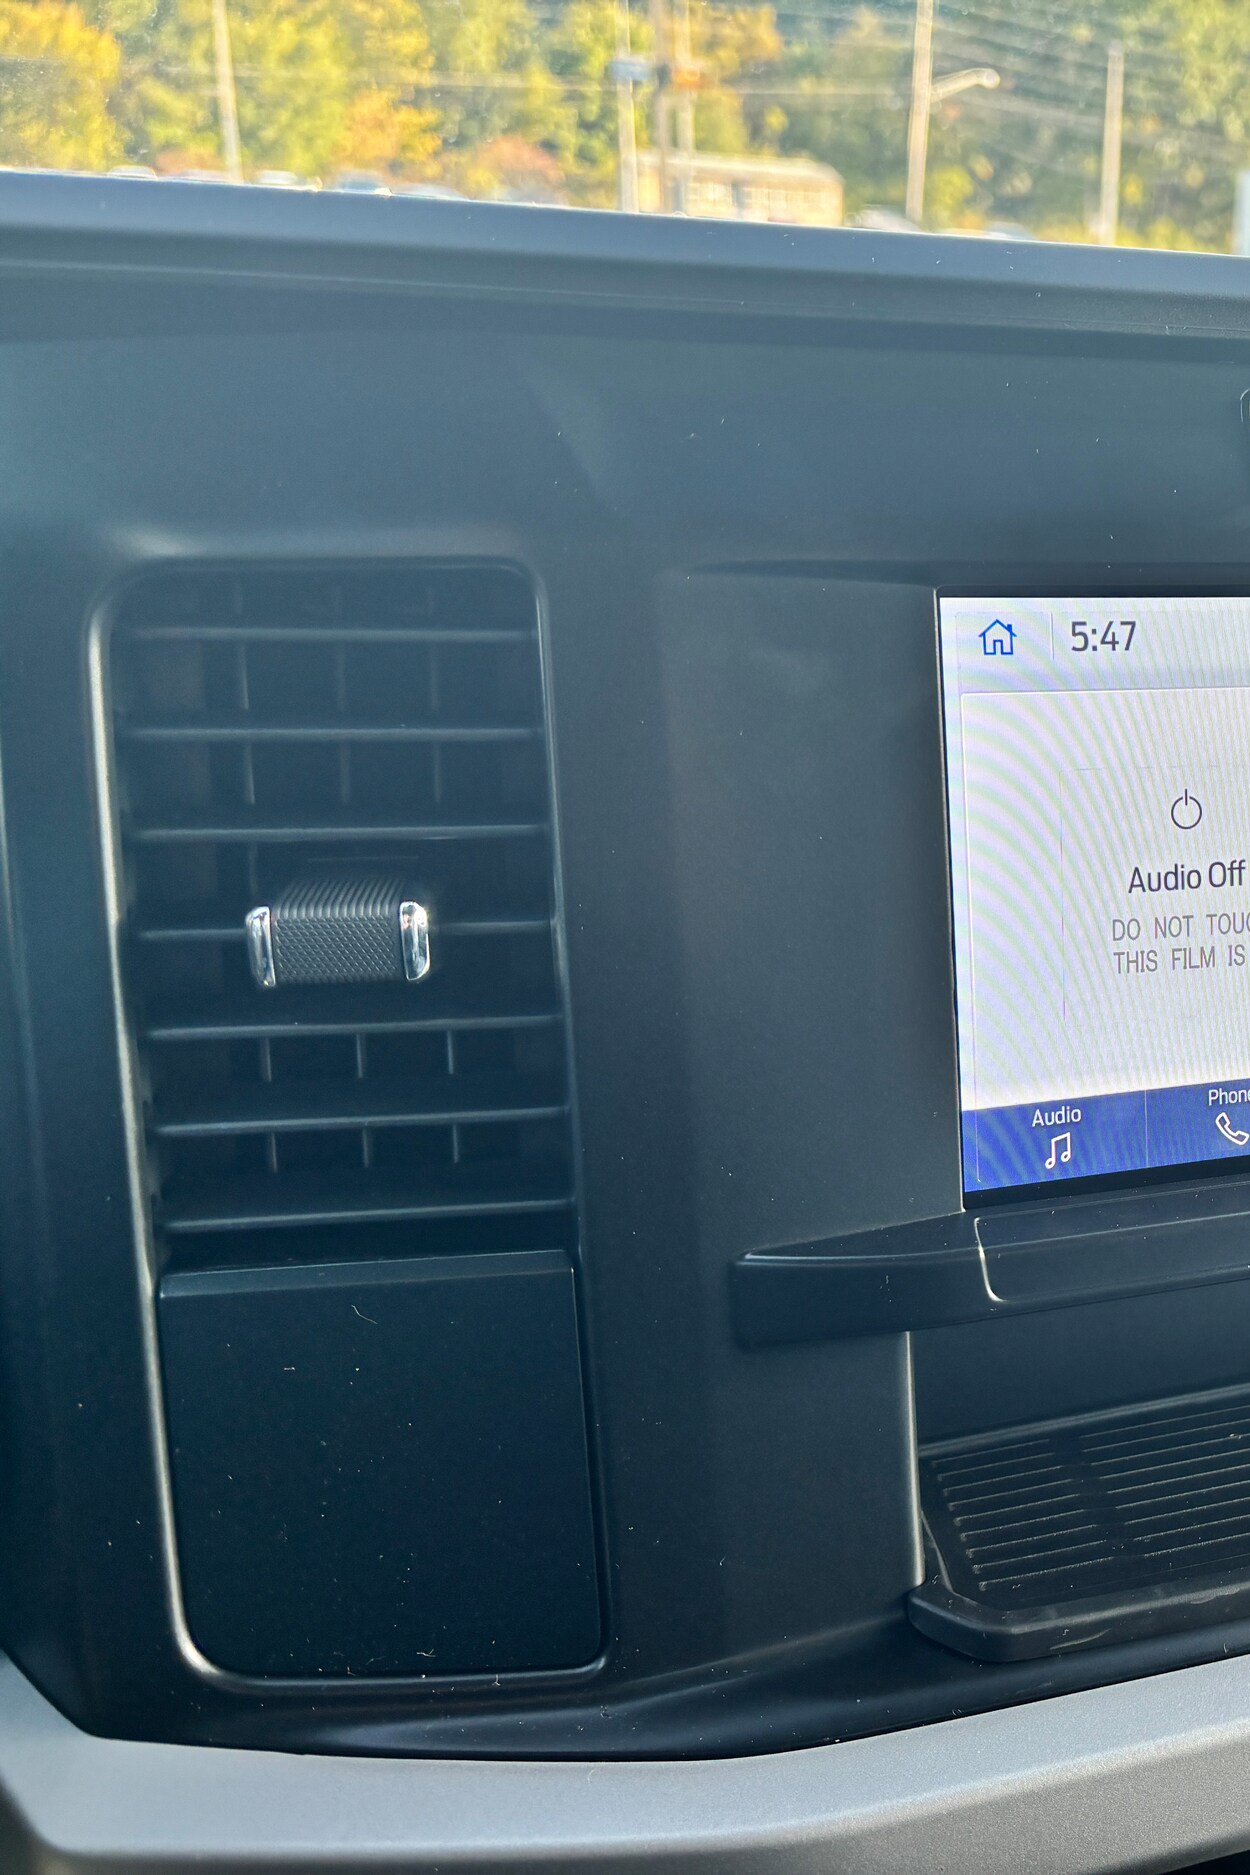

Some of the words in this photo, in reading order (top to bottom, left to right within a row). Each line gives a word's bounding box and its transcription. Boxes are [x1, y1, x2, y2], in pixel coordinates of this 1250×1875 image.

[1070, 620, 1137, 652] 5:47
[1128, 865, 1202, 894] Audio
[1208, 860, 1247, 888] Off
[1112, 918, 1141, 942] DO
[1154, 915, 1194, 939] NOT
[1113, 949, 1158, 974] THIS
[1172, 946, 1216, 970] FILM
[1228, 944, 1246, 967] IS
[1031, 1106, 1082, 1128] Audio
